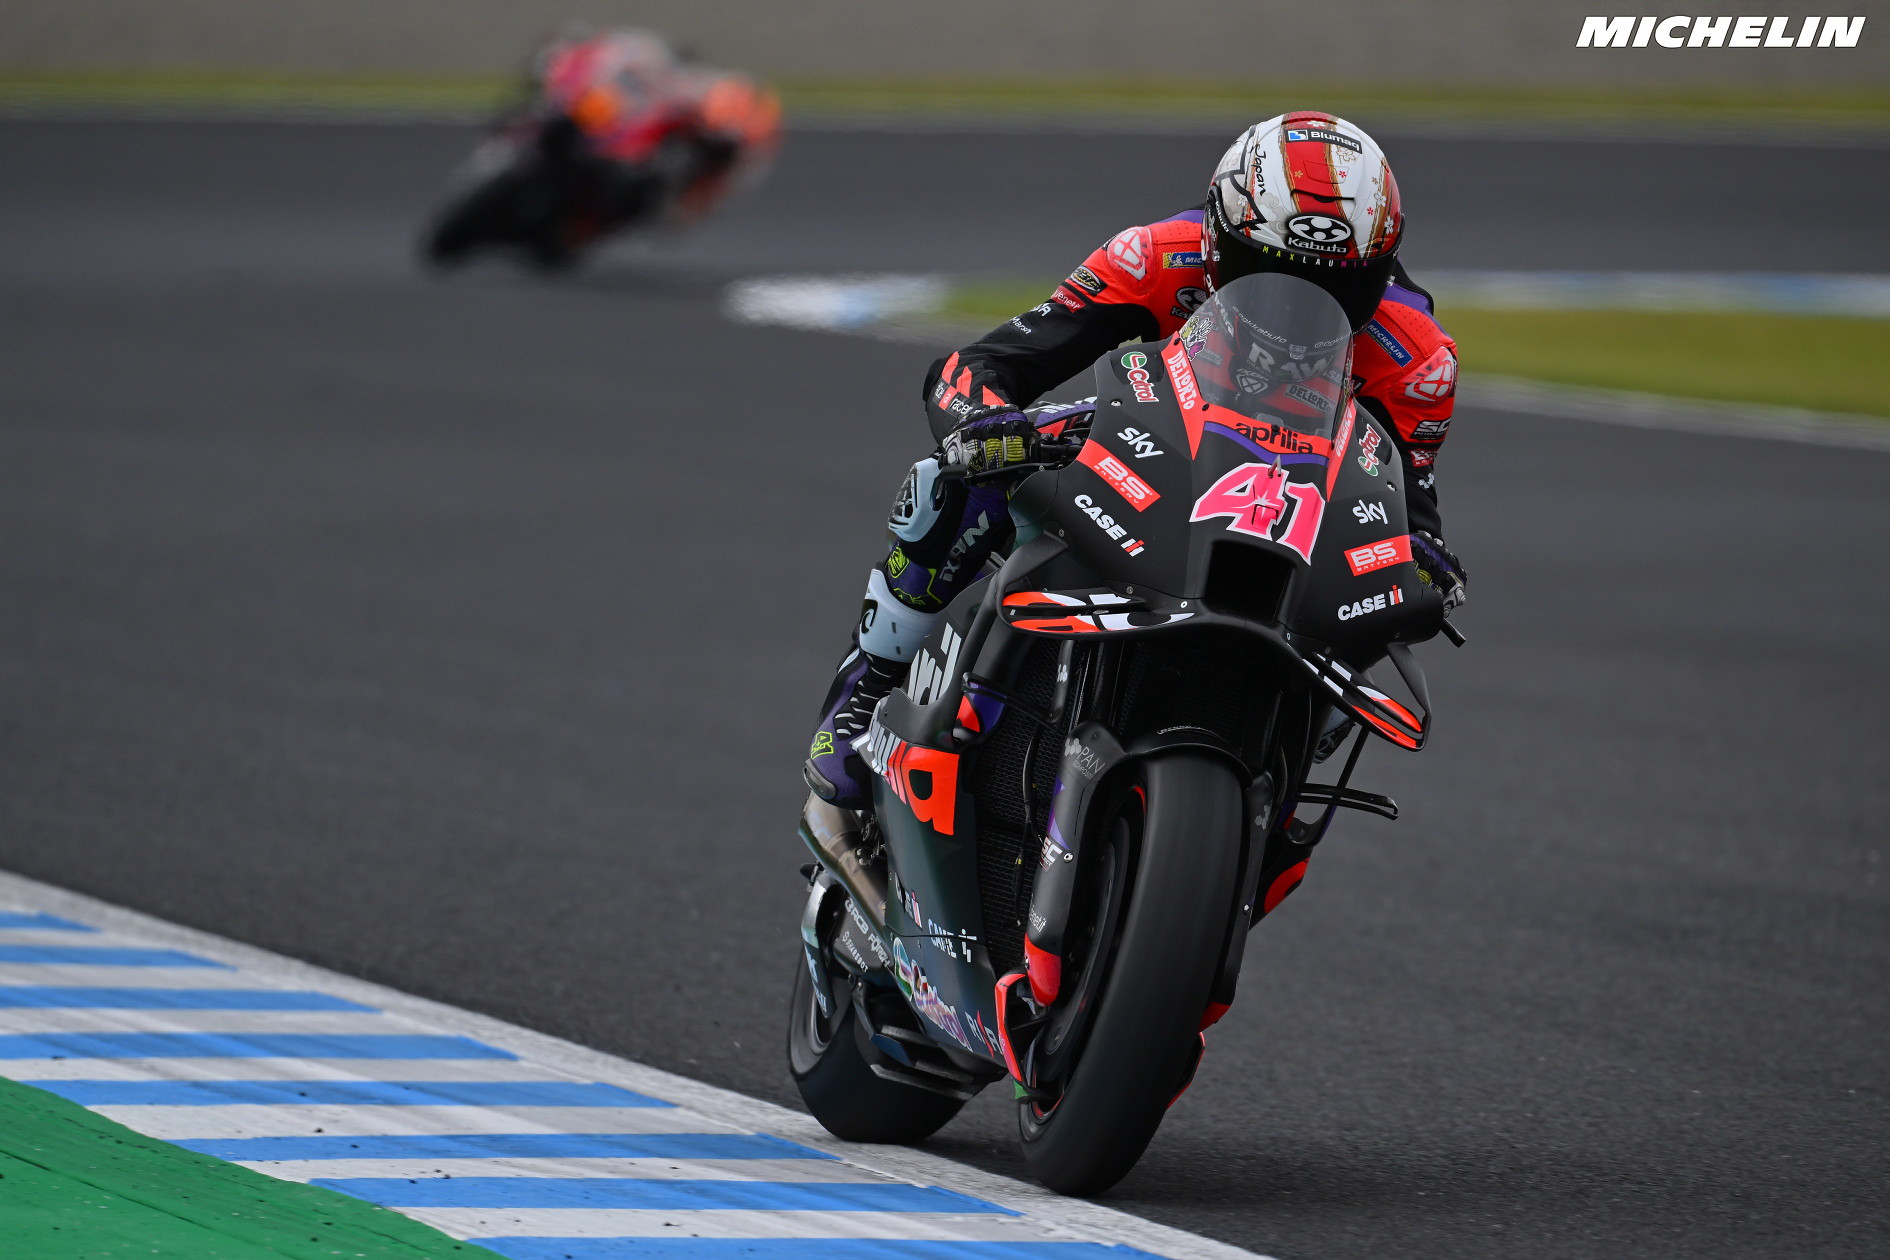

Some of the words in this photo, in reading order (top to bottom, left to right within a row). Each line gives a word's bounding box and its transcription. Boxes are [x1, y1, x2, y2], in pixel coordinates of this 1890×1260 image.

[1310, 131, 1361, 151] Blumaq
[1255, 144, 1267, 197] Japan
[1287, 236, 1347, 254] Kabuto
[1117, 427, 1164, 459] sky
[1236, 422, 1313, 454] aprilia
[1094, 465, 1139, 504] BATTERY
[1098, 456, 1151, 500] BS
[1074, 494, 1127, 540] CASE
[1189, 462, 1325, 566] 41
[1352, 500, 1388, 525] sky
[1349, 542, 1397, 568] BS
[1356, 555, 1400, 572] BATTERY
[1337, 594, 1386, 621] CASE
[1079, 746, 1106, 773] PAN
